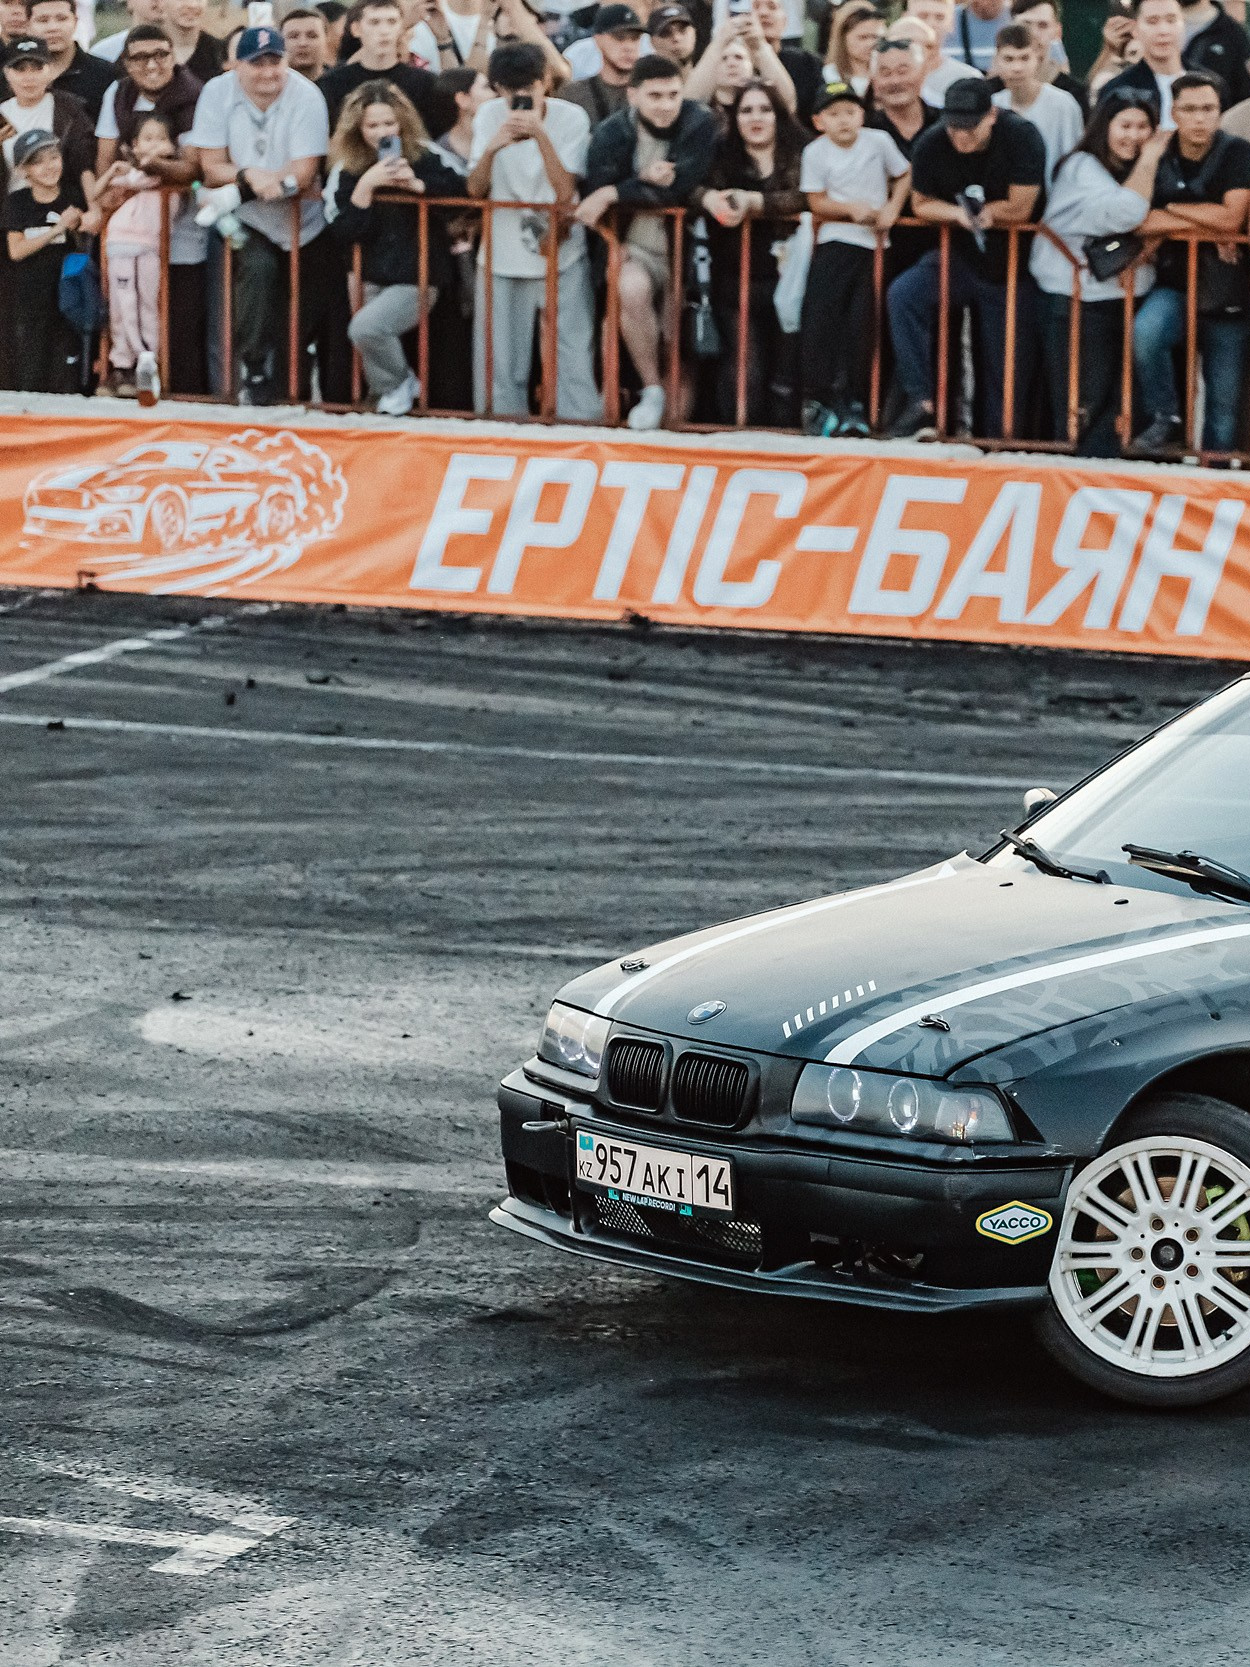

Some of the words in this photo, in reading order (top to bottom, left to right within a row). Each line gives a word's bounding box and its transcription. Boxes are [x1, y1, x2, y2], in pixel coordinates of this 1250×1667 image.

[409, 452, 1246, 636] ЕРТІС-БАЯН
[579, 1160, 594, 1179] KZ
[595, 1143, 637, 1188] 957
[642, 1162, 685, 1199] AKI
[696, 1164, 730, 1206] 14
[622, 1192, 637, 1204] NEW
[989, 1216, 1041, 1230] YACCO
